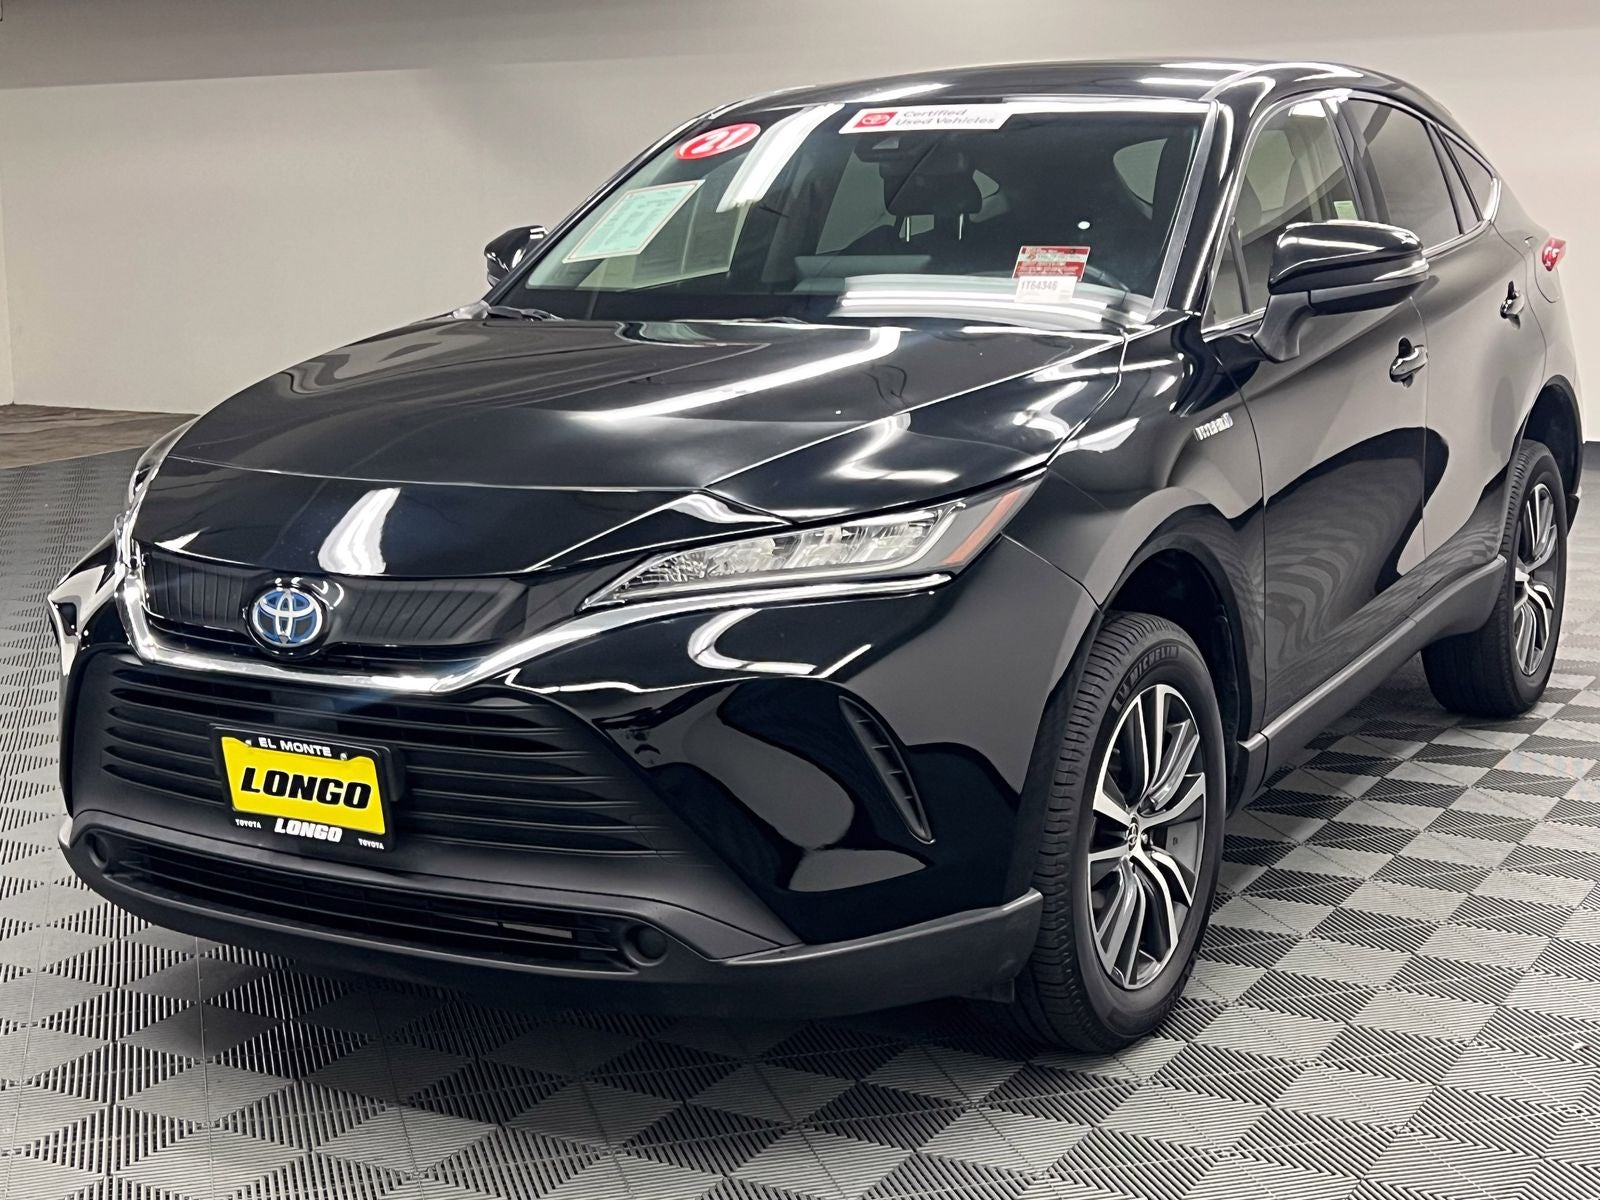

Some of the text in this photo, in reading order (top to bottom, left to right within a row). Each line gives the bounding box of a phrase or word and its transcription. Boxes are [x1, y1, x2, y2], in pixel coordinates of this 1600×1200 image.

[895, 117, 996, 126] Used Vehicles
[903, 109, 967, 117] Certified
[691, 126, 748, 154] 21
[1130, 646, 1177, 686] MICHELIN
[258, 737, 332, 758] EL MONTE
[240, 767, 372, 809] LONGO
[235, 818, 262, 830] TOYOTA
[273, 817, 343, 843] LONGO
[357, 838, 385, 849] TOYOTA
